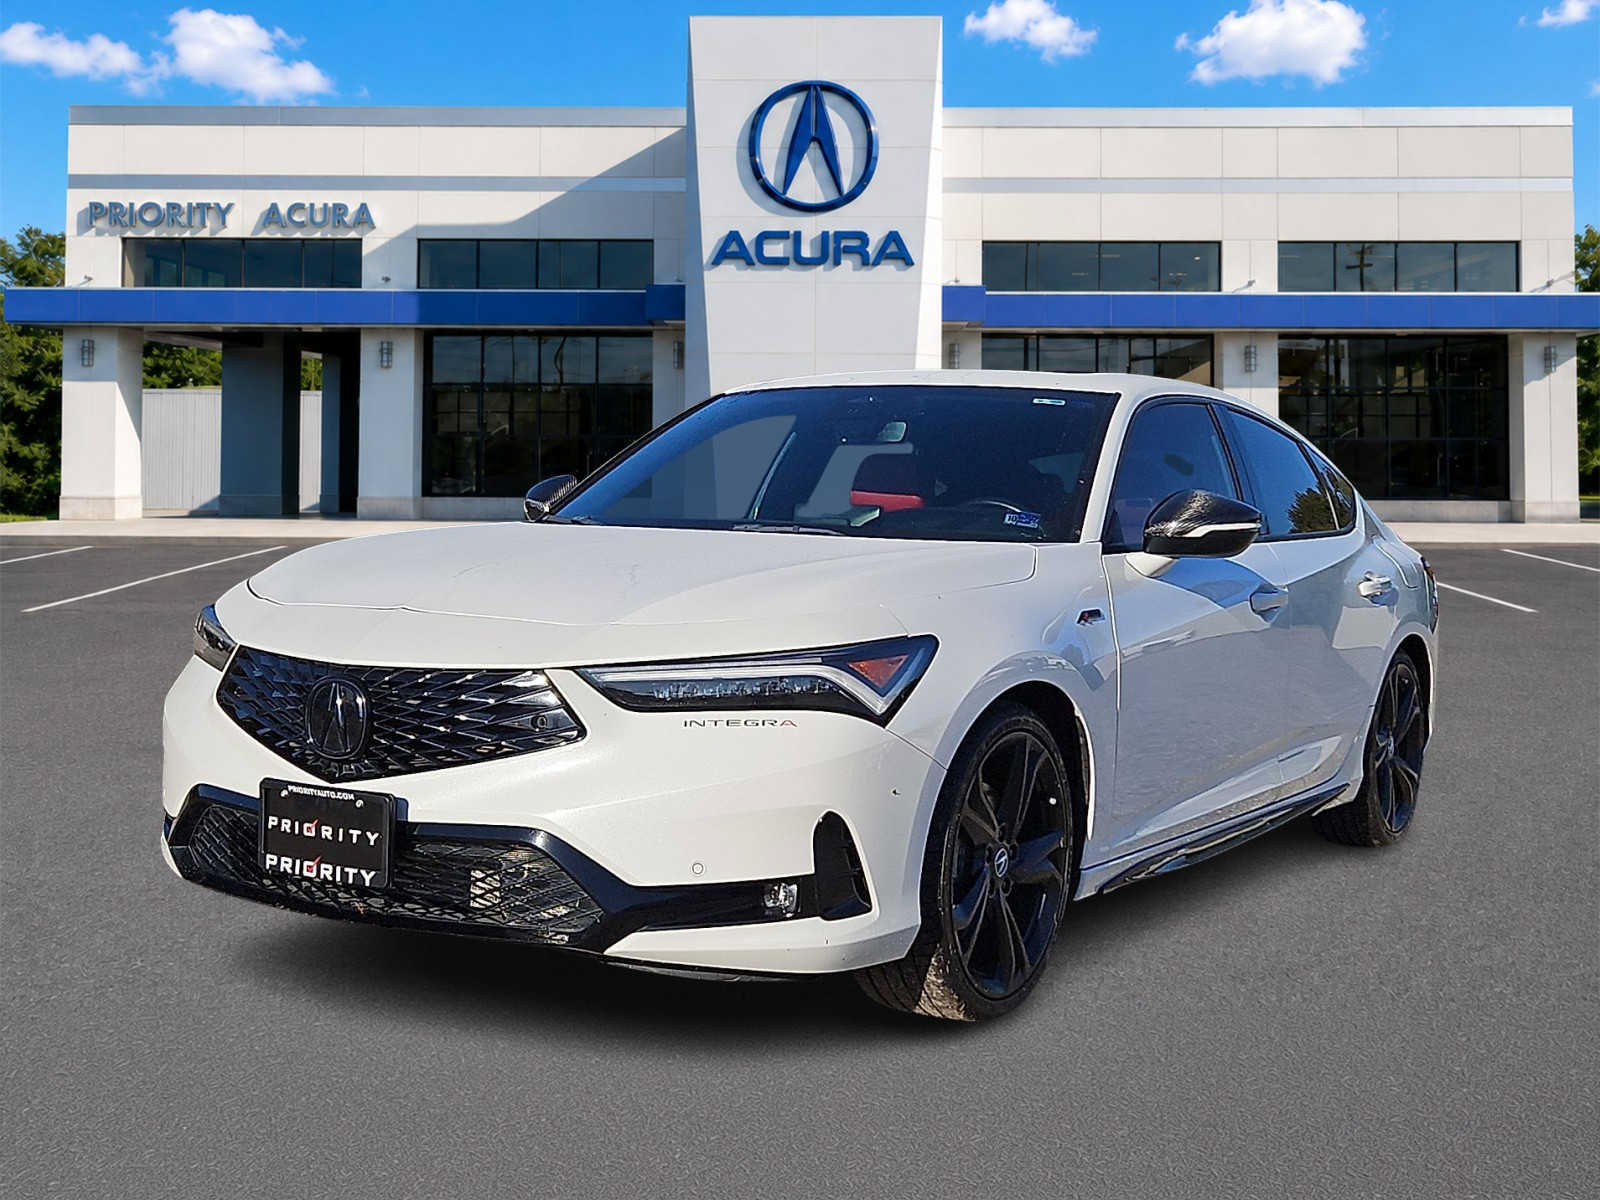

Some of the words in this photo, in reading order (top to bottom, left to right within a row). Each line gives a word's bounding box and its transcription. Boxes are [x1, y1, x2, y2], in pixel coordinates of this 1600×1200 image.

[88, 201, 234, 228] PRIORITY
[262, 202, 376, 229] ACURA
[711, 230, 915, 266] ACURA
[683, 719, 798, 728] INTEGRA
[287, 785, 355, 800] PRIORITYAUTO.COM
[267, 815, 382, 846] PRIORITY
[265, 853, 377, 887] PRIORITY
